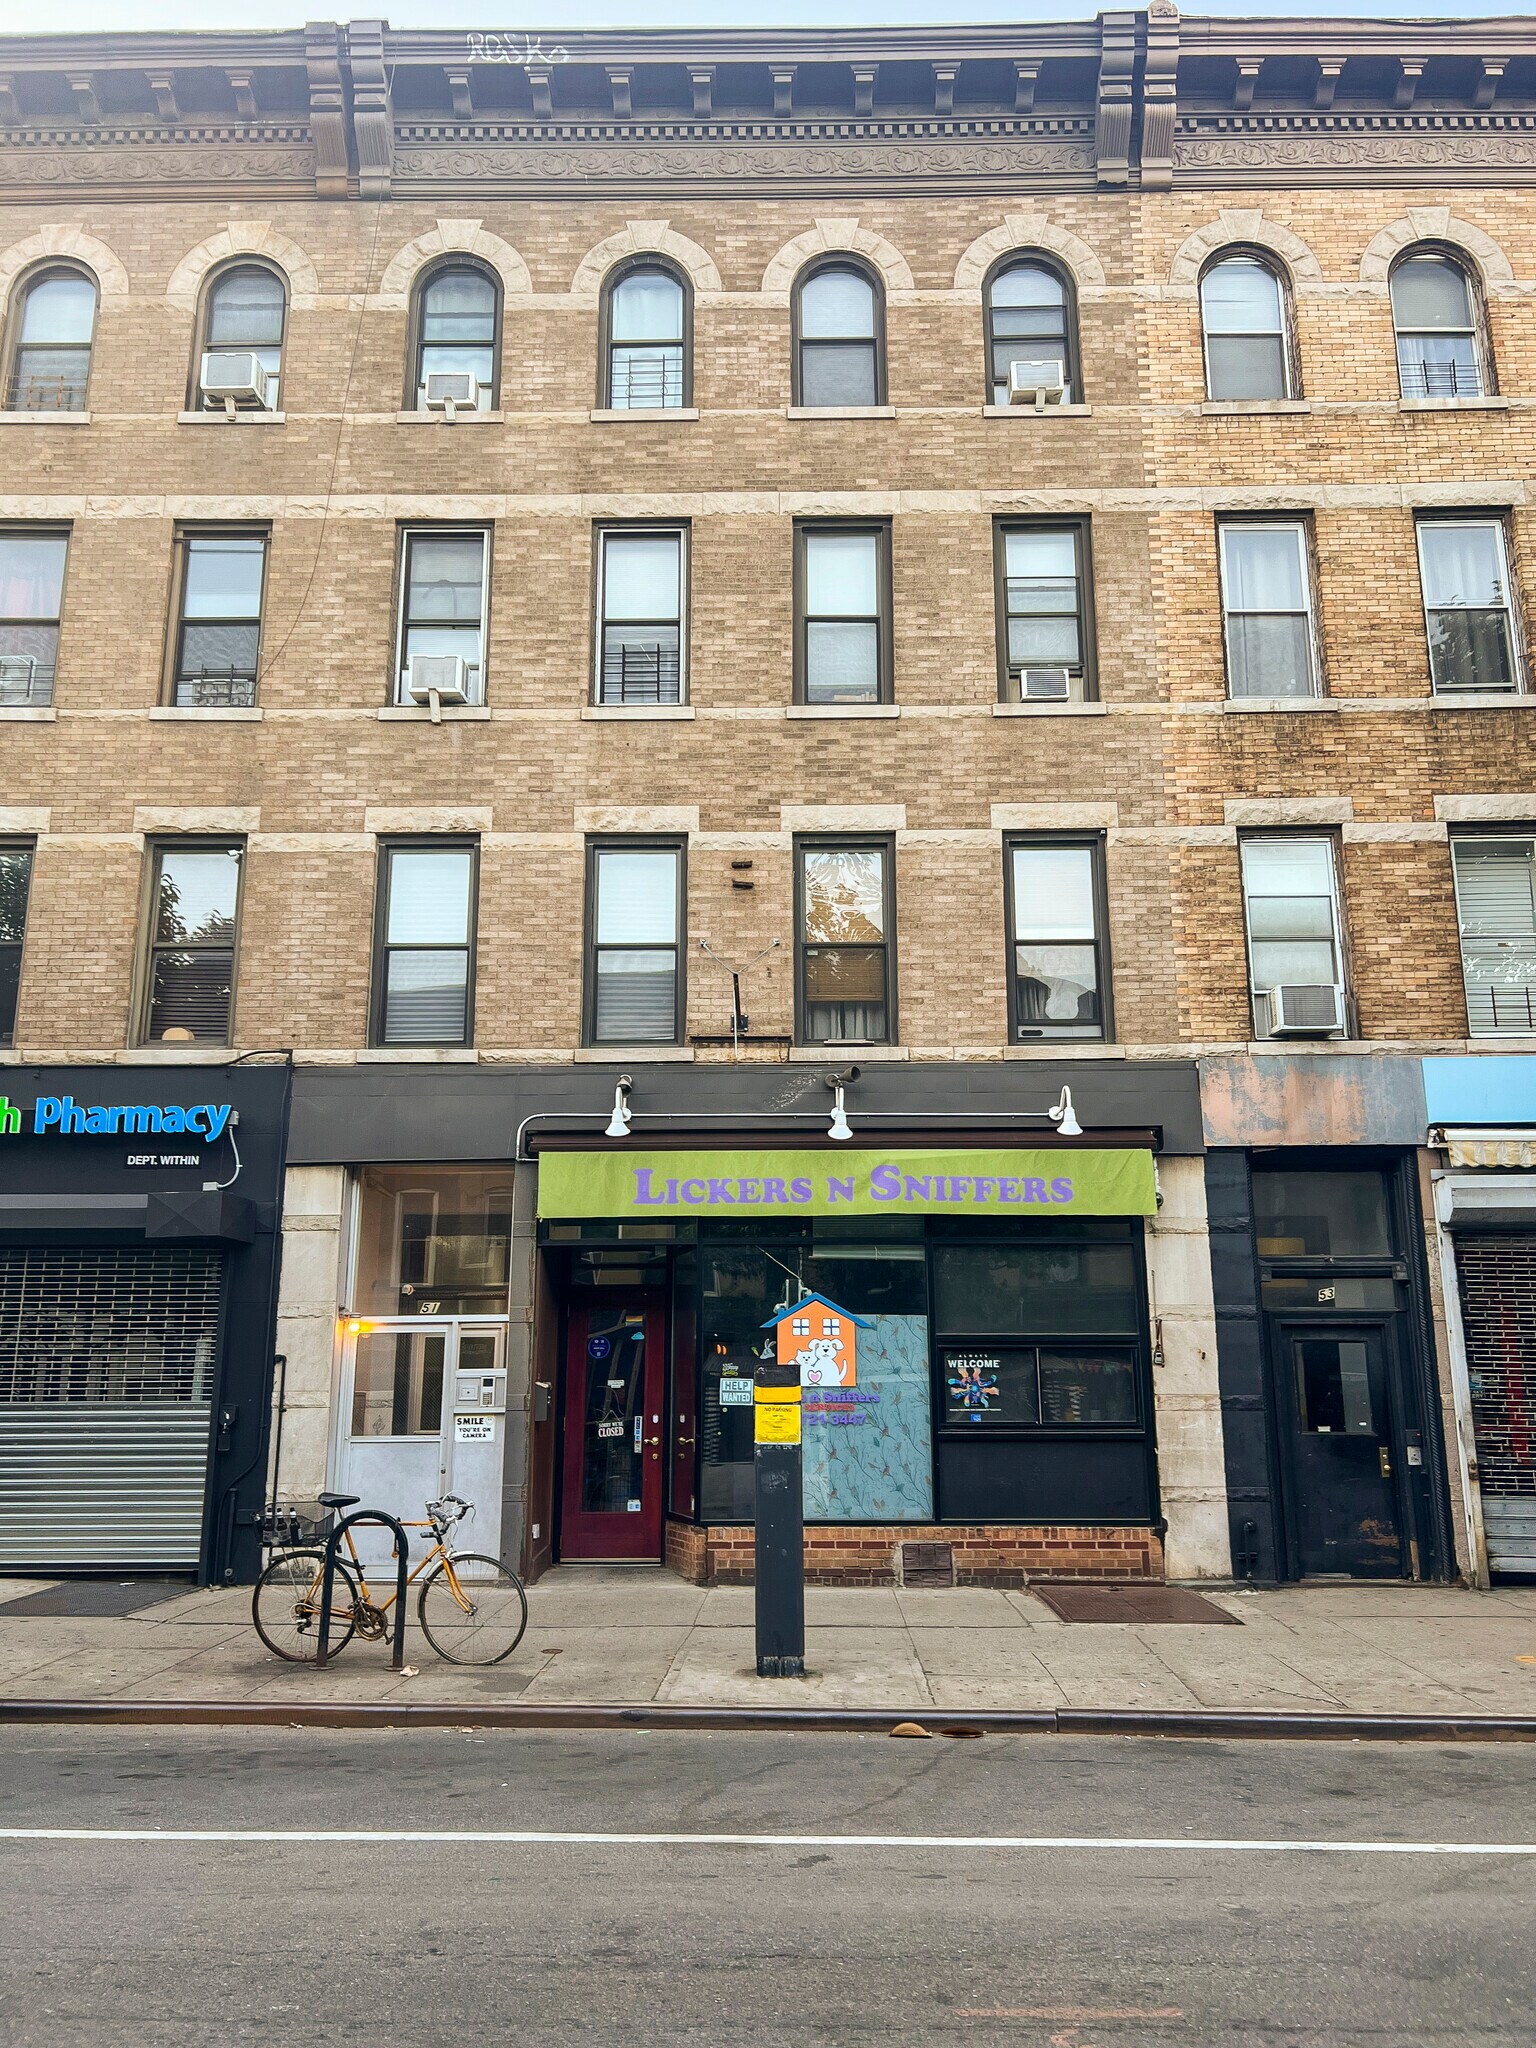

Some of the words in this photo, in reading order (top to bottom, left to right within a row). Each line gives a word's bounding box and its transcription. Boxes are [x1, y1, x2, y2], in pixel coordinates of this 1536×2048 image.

[34, 1096, 231, 1142] Pharmacy
[127, 1155, 158, 1165] DEPT.
[160, 1155, 199, 1165] WITHIN
[1319, 1288, 1334, 1299] 53
[421, 1303, 437, 1313] 51
[948, 1360, 1001, 1368] WELCOME
[724, 1381, 749, 1390] HELP
[722, 1392, 751, 1402] WANTED
[823, 1391, 880, 1402] Sniffers
[457, 1417, 484, 1425] SMILE
[598, 1427, 624, 1437] CLOSED
